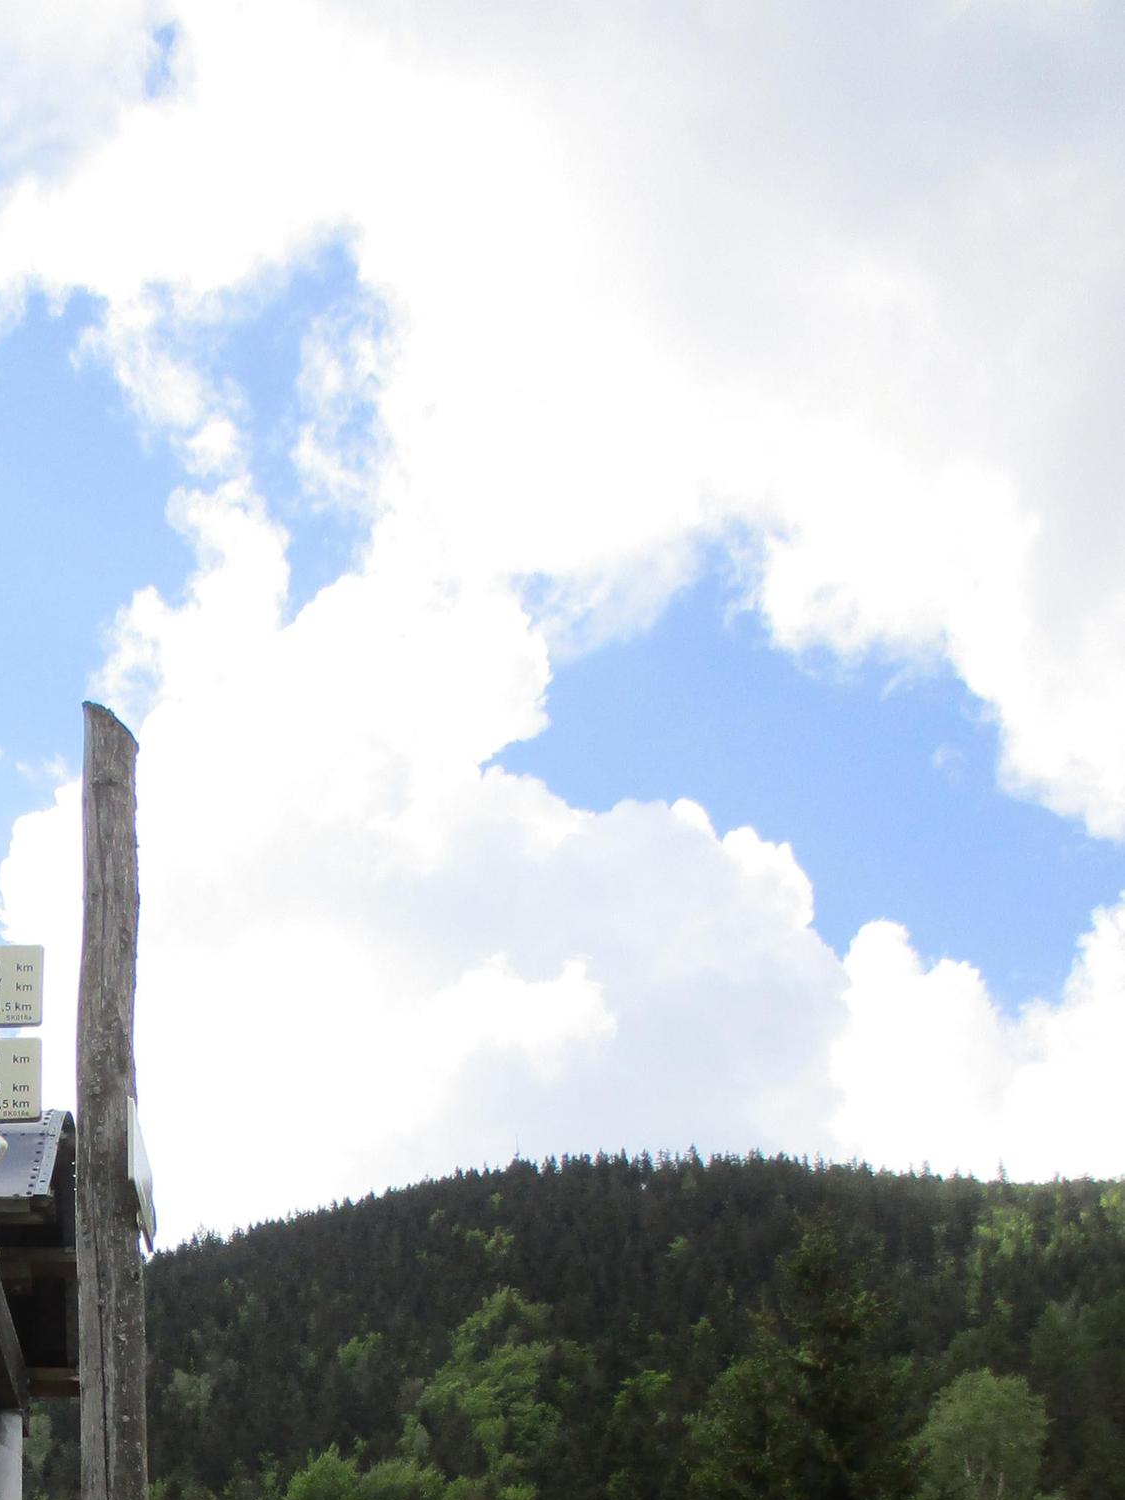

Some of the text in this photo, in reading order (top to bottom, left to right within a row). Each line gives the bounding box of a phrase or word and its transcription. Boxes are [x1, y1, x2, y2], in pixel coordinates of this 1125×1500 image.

[16, 963, 33, 972] km
[16, 982, 33, 991] km
[15, 1002, 32, 1011] km
[12, 1054, 30, 1063] km
[12, 1083, 30, 1092] km
[12, 1099, 30, 1108] km
